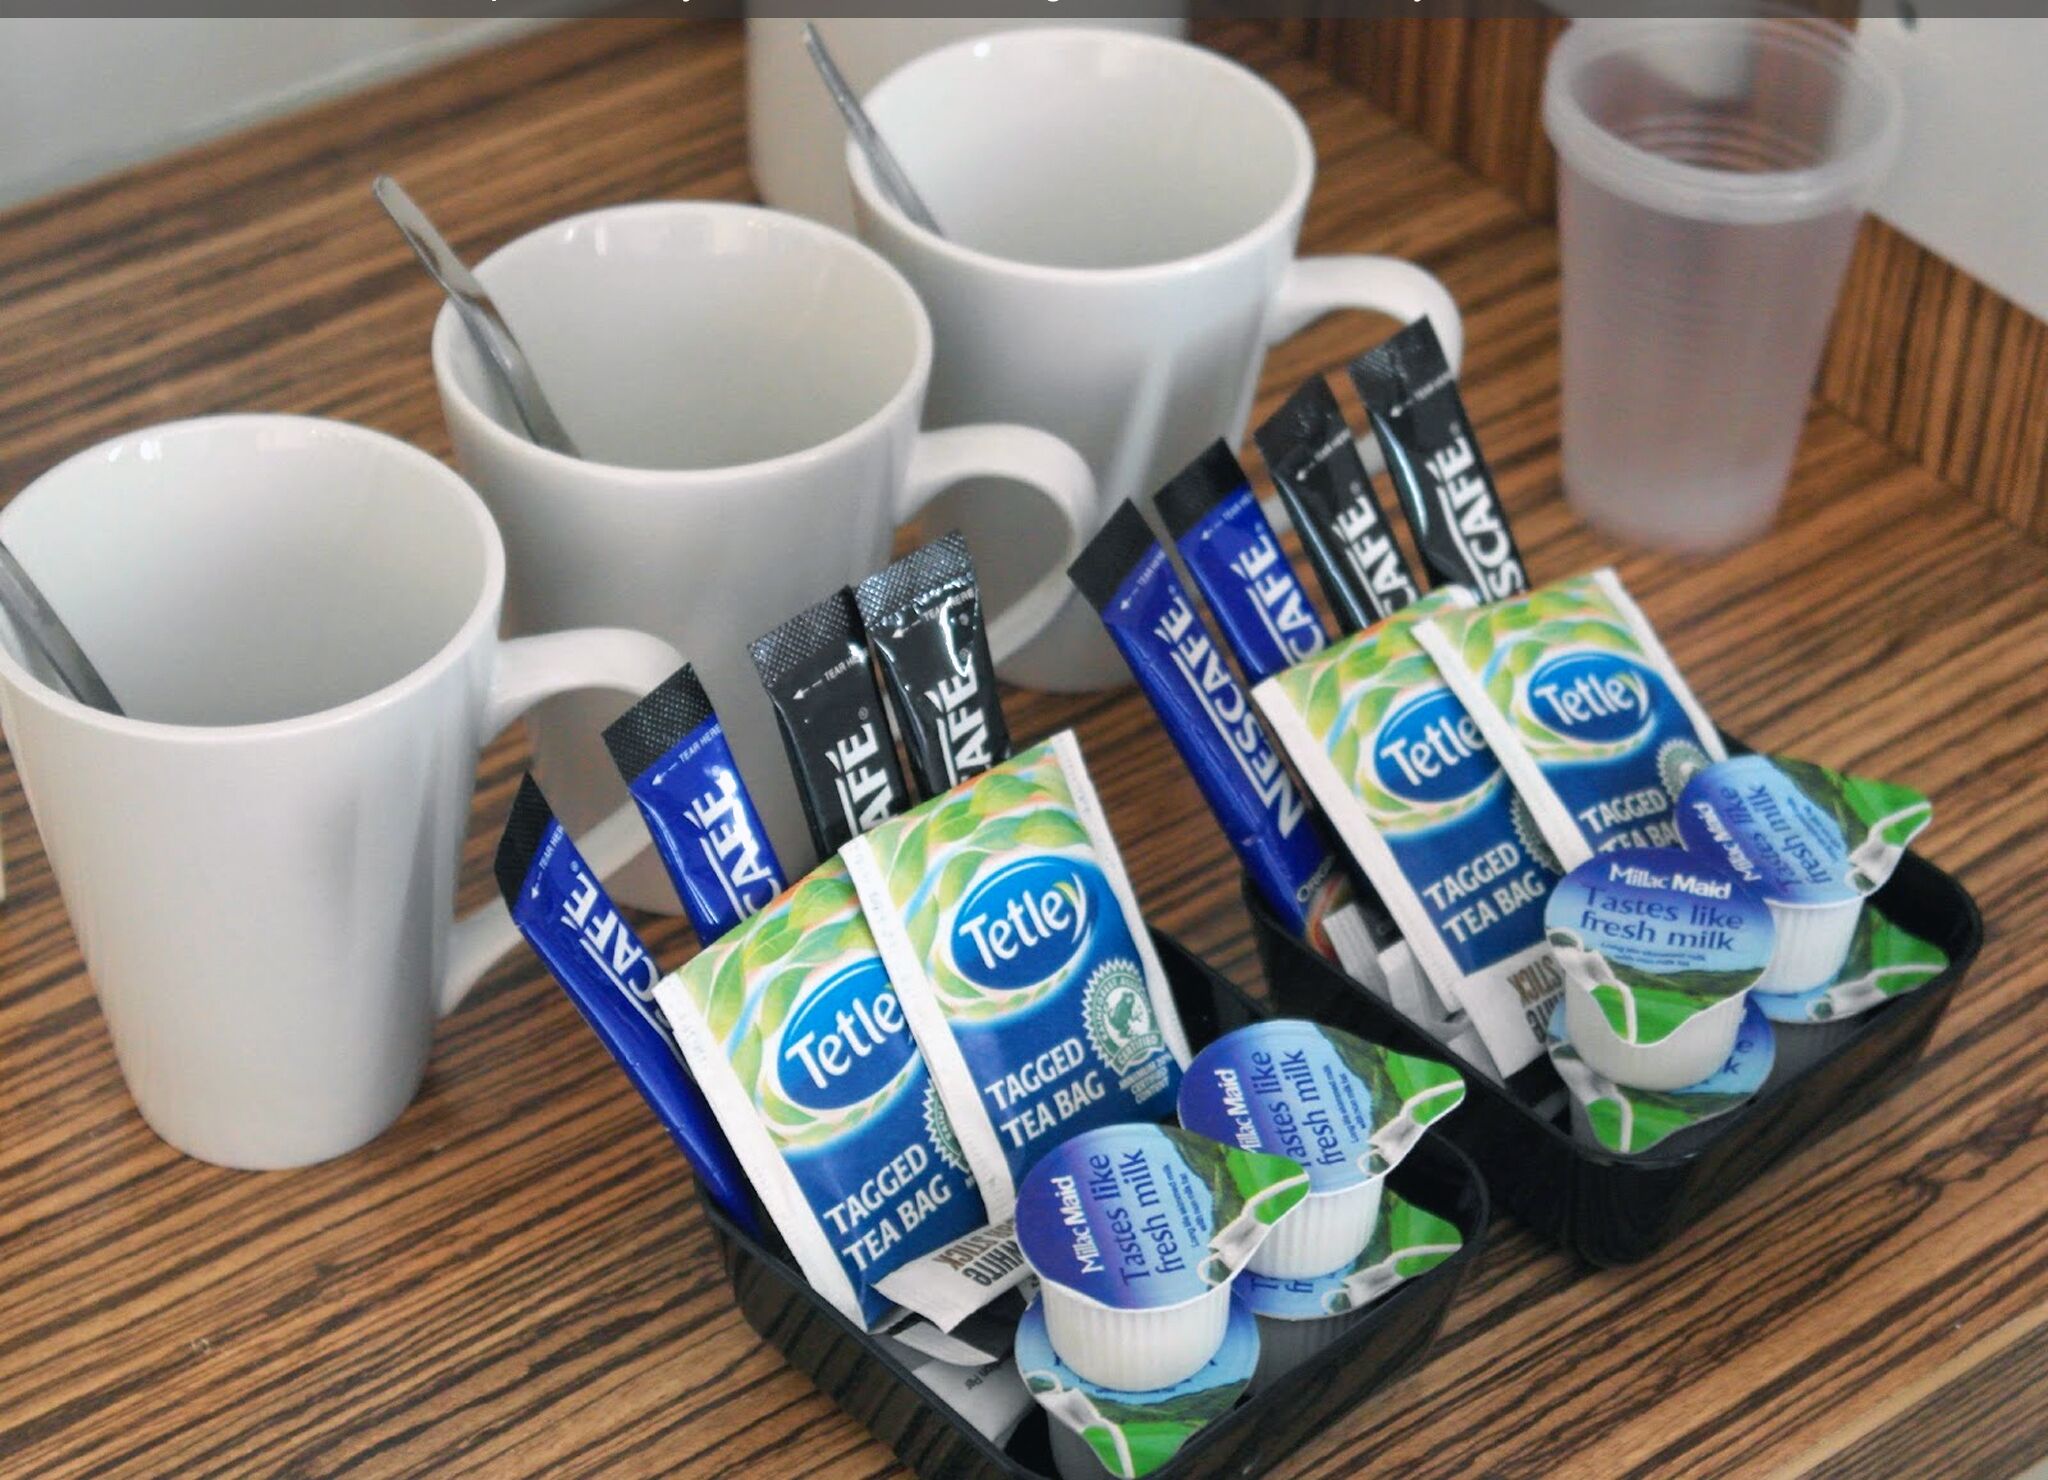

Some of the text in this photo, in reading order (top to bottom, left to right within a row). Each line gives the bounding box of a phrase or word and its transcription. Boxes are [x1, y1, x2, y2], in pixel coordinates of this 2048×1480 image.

[1331, 494, 1418, 615] CAFÉ
[1425, 436, 1525, 600] SCAFÉ
[1230, 534, 1325, 663] CAFÉ
[1534, 669, 1650, 726] Tetley
[1380, 714, 1488, 787] Tetle
[683, 769, 782, 916] CAFÉ
[1578, 788, 1669, 834] TAGGED
[1644, 820, 1682, 849] BA
[1747, 784, 1793, 833] milk
[1422, 841, 1521, 912] TAGGED
[1608, 862, 1733, 900] Millac Maid
[1783, 833, 1833, 885] fresh
[560, 870, 664, 1004] CAFÉ
[958, 870, 1087, 972] Tetley
[1441, 870, 1546, 944] TEA BAG
[1580, 909, 1736, 951] fresh milk
[1585, 884, 1744, 930] Tastes like
[784, 990, 906, 1091] Tetle
[984, 1037, 1085, 1112] TAGGED
[1000, 1096, 1056, 1151] TEA
[1054, 1069, 1106, 1126] BAG
[1214, 1068, 1263, 1150] illac Maid
[1251, 1050, 1312, 1167] astes like
[1279, 1049, 1346, 1166] fresh milk
[822, 1143, 930, 1235] TAGGED
[842, 1173, 952, 1273] TEA BAG
[1050, 1175, 1088, 1226] Maid
[1089, 1153, 1152, 1287] Tastes like
[1118, 1148, 1187, 1274] fresh milk
